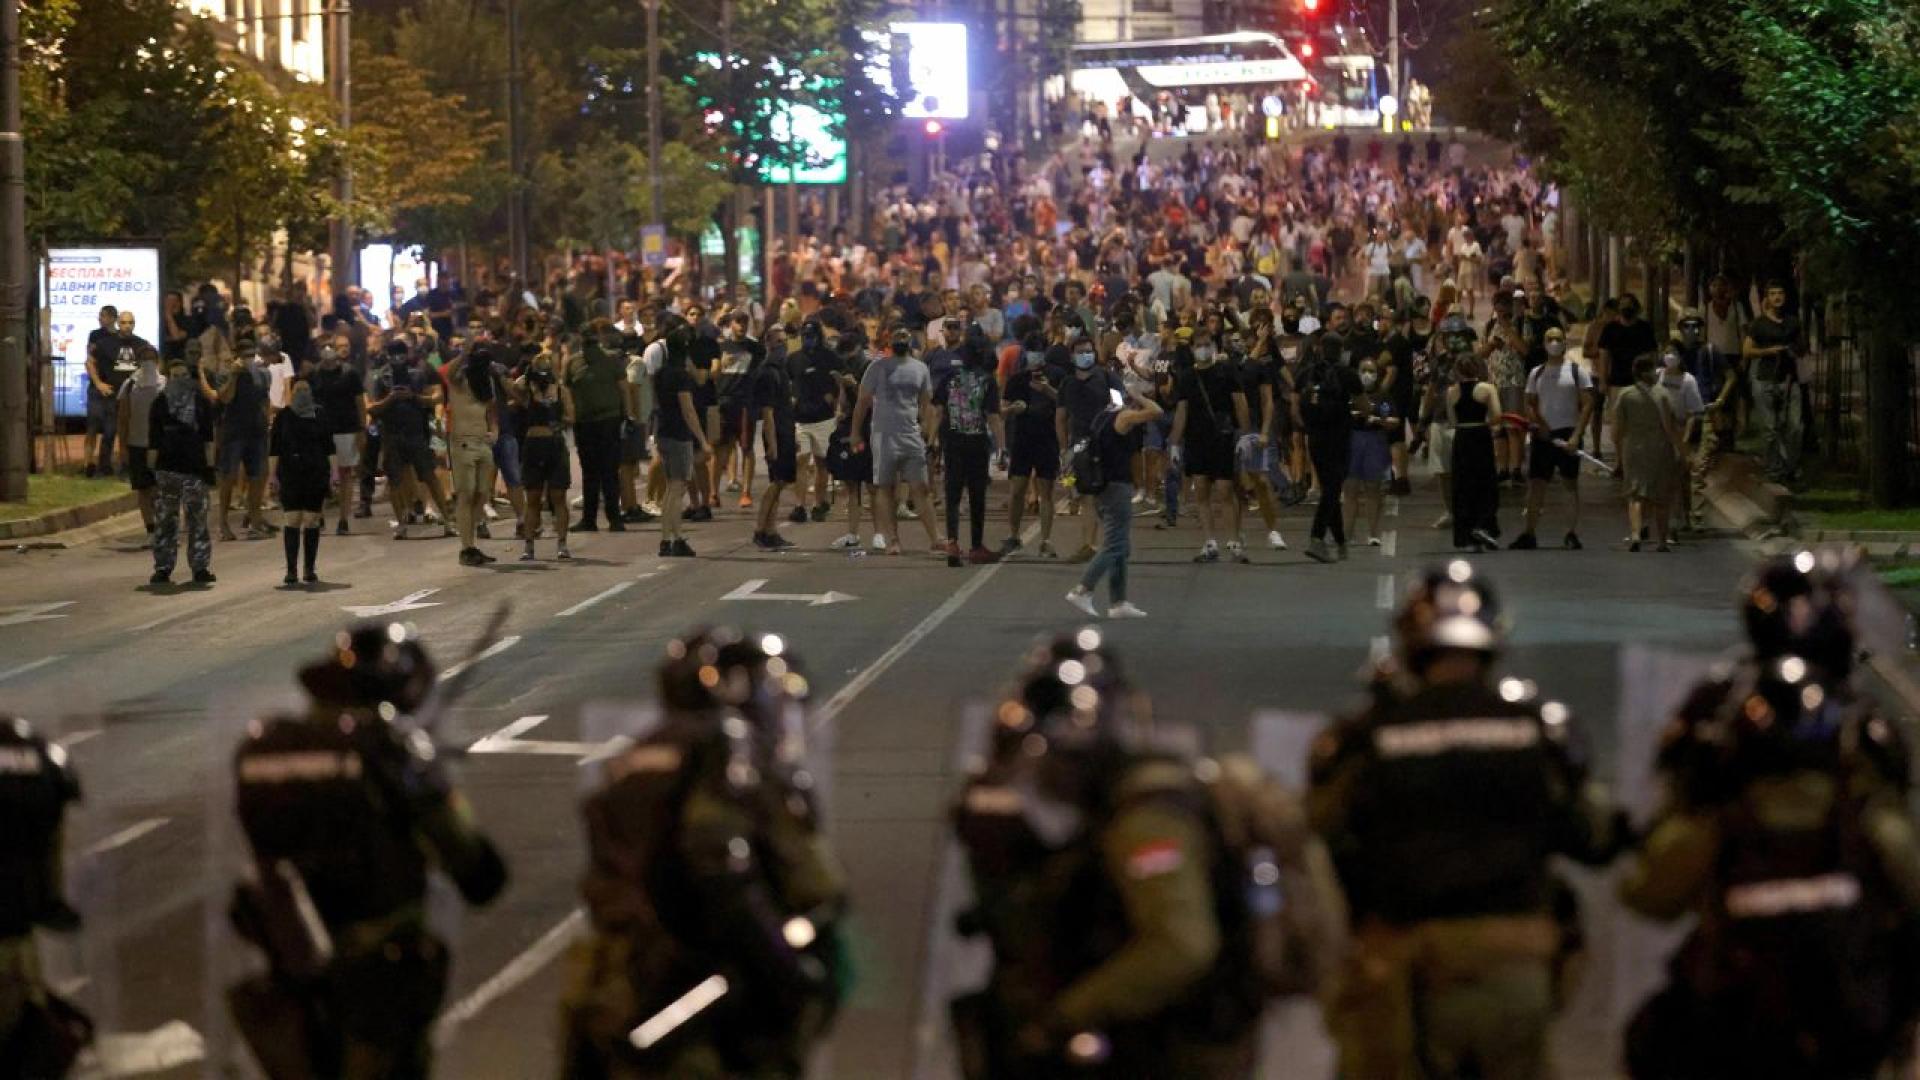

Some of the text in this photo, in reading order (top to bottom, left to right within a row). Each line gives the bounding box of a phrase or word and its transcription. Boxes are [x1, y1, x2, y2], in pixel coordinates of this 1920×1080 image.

[48, 267, 132, 279] БЕСПЛАТАН
[99, 281, 152, 292] ПРЕВОЗ
[50, 294, 97, 305] ЗА СВЕ
